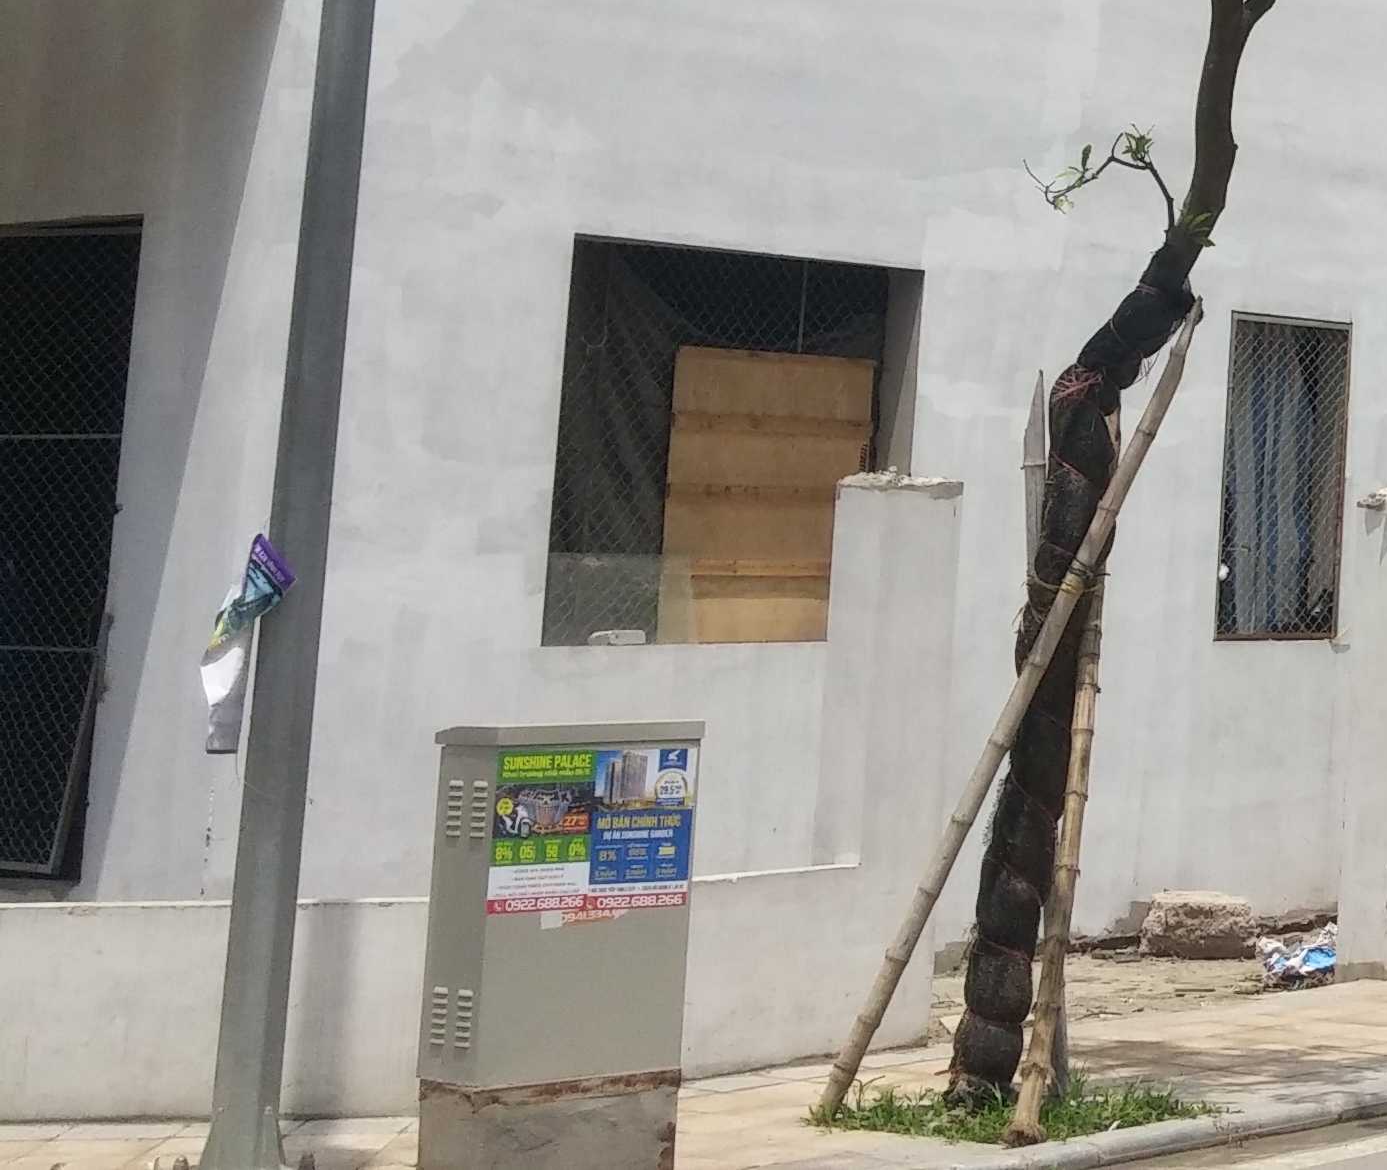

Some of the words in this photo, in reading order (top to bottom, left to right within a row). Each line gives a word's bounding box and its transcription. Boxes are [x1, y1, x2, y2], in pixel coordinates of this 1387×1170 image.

[503, 755, 553, 770] SUNSHINE
[554, 752, 593, 768] PALACE
[496, 846, 513, 860] 8%
[568, 842, 586, 856] 0%
[505, 896, 584, 912] 0922.688.266
[596, 894, 682, 909] 0922.688.266
